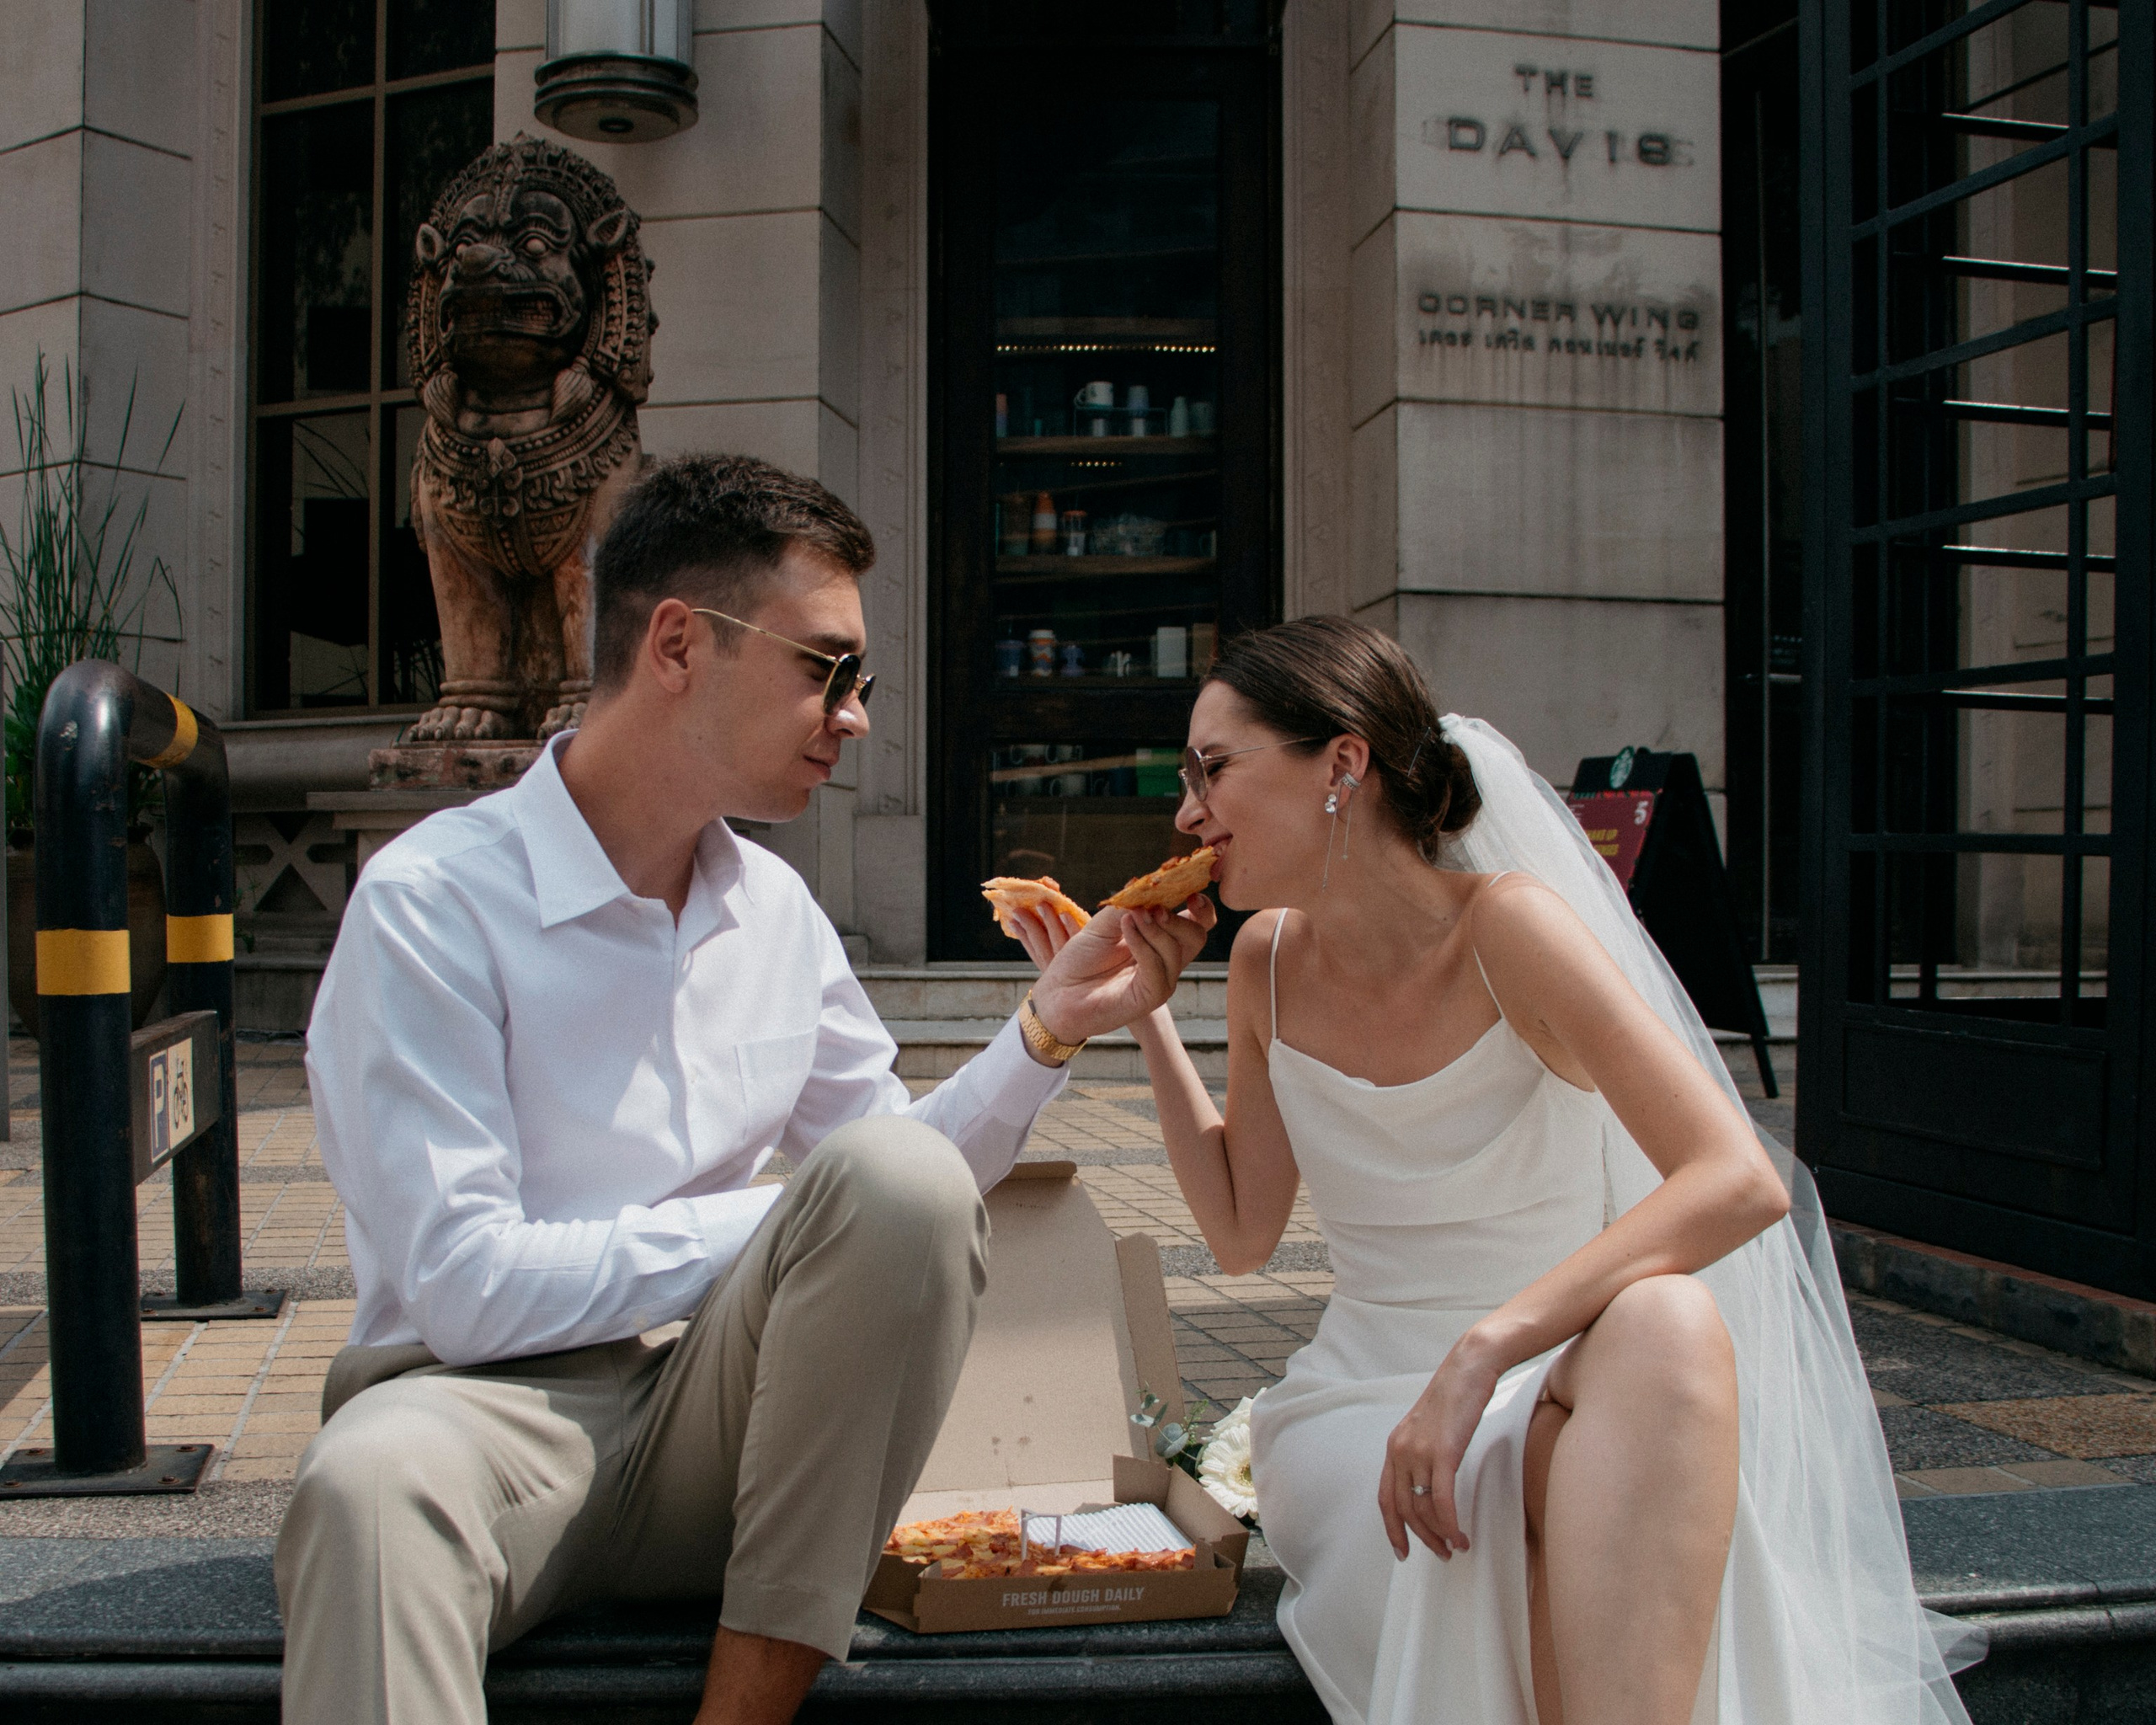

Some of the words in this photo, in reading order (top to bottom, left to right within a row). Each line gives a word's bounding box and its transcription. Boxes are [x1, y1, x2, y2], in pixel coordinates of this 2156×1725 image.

[1513, 64, 1594, 99] THE
[1448, 116, 1673, 166] DAVIS
[1418, 292, 1577, 323] CORNER
[1590, 302, 1700, 330] WING
[153, 1063, 165, 1149] P
[1001, 1591, 1048, 1607] FRESH
[1052, 1589, 1101, 1605] DOUGH
[1104, 1586, 1145, 1602] DAILY
[1041, 1605, 1076, 1615] IMMEDIATE
